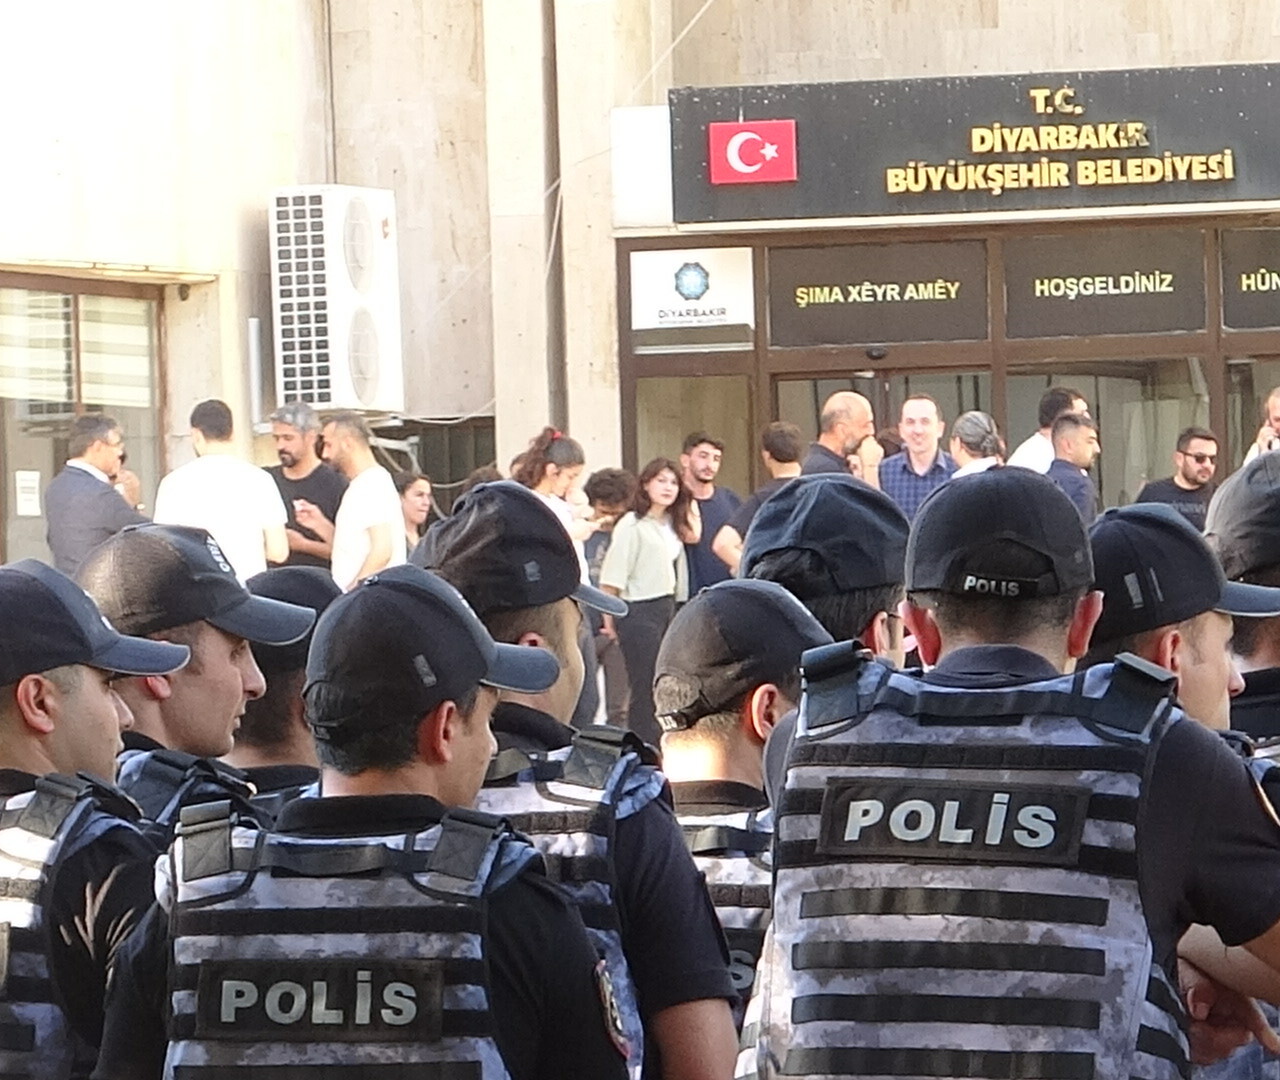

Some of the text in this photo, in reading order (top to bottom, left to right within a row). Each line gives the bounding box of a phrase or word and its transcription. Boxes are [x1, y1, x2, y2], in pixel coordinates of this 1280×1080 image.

[1029, 86, 1084, 114] T.C.
[885, 148, 1235, 196] BÜYÜKŞEHİR BELEDİYESİ
[795, 279, 961, 308] ŞIMA XÊYR AMÊY
[1034, 270, 1174, 301] HOŞGELDİNİZ
[842, 792, 1058, 849] POLİS
[219, 970, 419, 1027] POLİS
